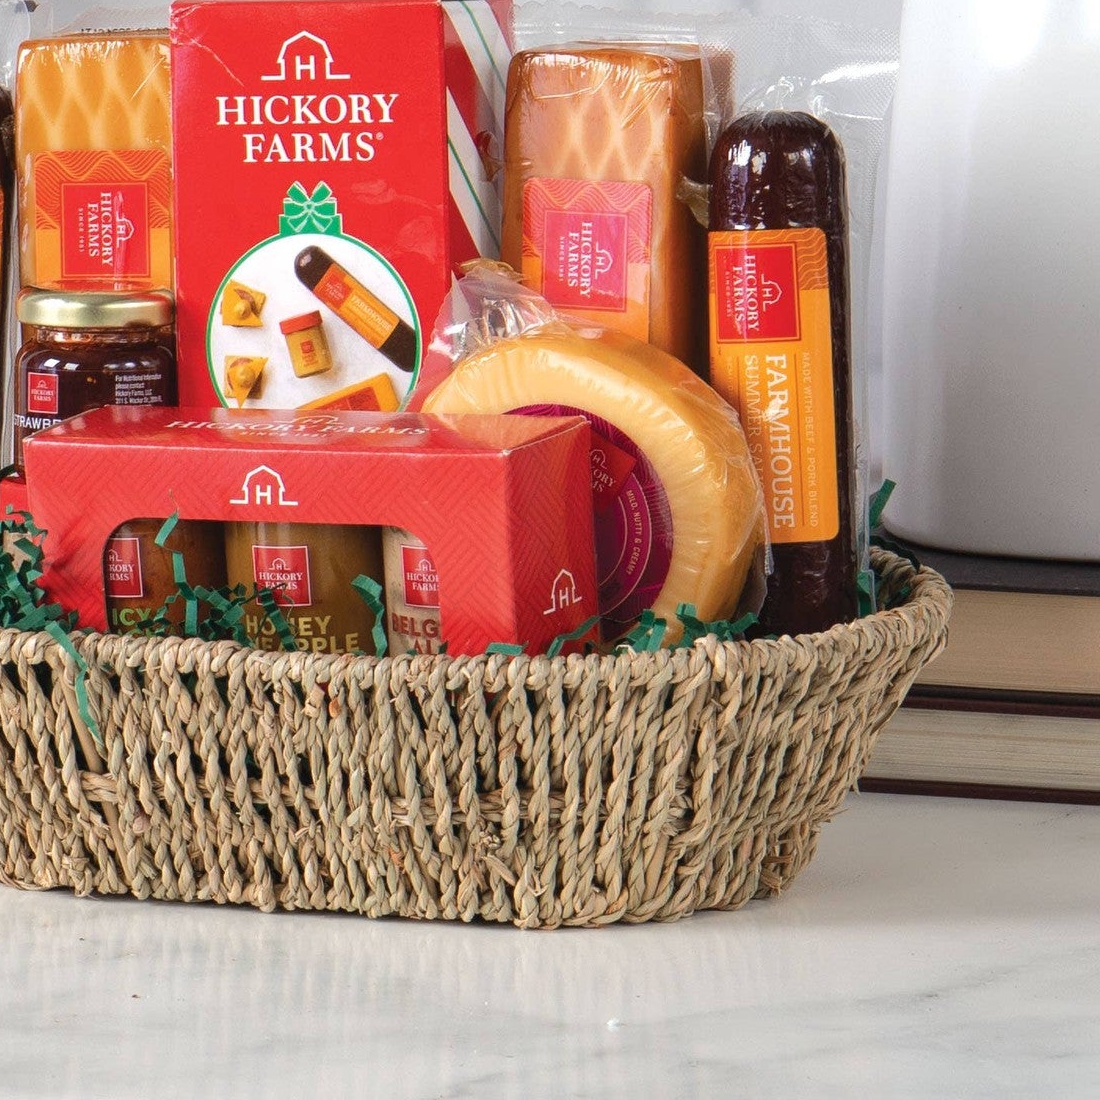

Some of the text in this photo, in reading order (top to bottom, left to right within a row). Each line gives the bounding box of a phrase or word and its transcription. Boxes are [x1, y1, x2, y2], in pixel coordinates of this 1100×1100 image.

[216, 94, 399, 125] HICKORY
[87, 203, 100, 257] FARMS
[100, 192, 113, 267] HICKORY
[568, 232, 580, 287] FARMS
[580, 222, 593, 299] HICKORY
[733, 266, 745, 322] FARMS
[744, 255, 759, 332] HICKORY
[744, 355, 762, 437] SUMMER
[164, 421, 430, 435] HICKORY FARMS
[802, 352, 819, 528] MADE WITH BEEF & PORK BLEND
[766, 354, 796, 529] FARMHOUSE
[593, 469, 617, 487] ORY
[626, 489, 638, 511] MILD,
[632, 511, 643, 536] NUTTY
[109, 564, 134, 572] KORY
[626, 546, 642, 576] CREAMY
[109, 573, 130, 581] RMS
[259, 572, 303, 581] HICKORY
[412, 582, 439, 591] FARM
[112, 608, 151, 626] ICY
[392, 612, 439, 638] BELG
[253, 633, 360, 654] EPPLE
[414, 640, 437, 655] AL
